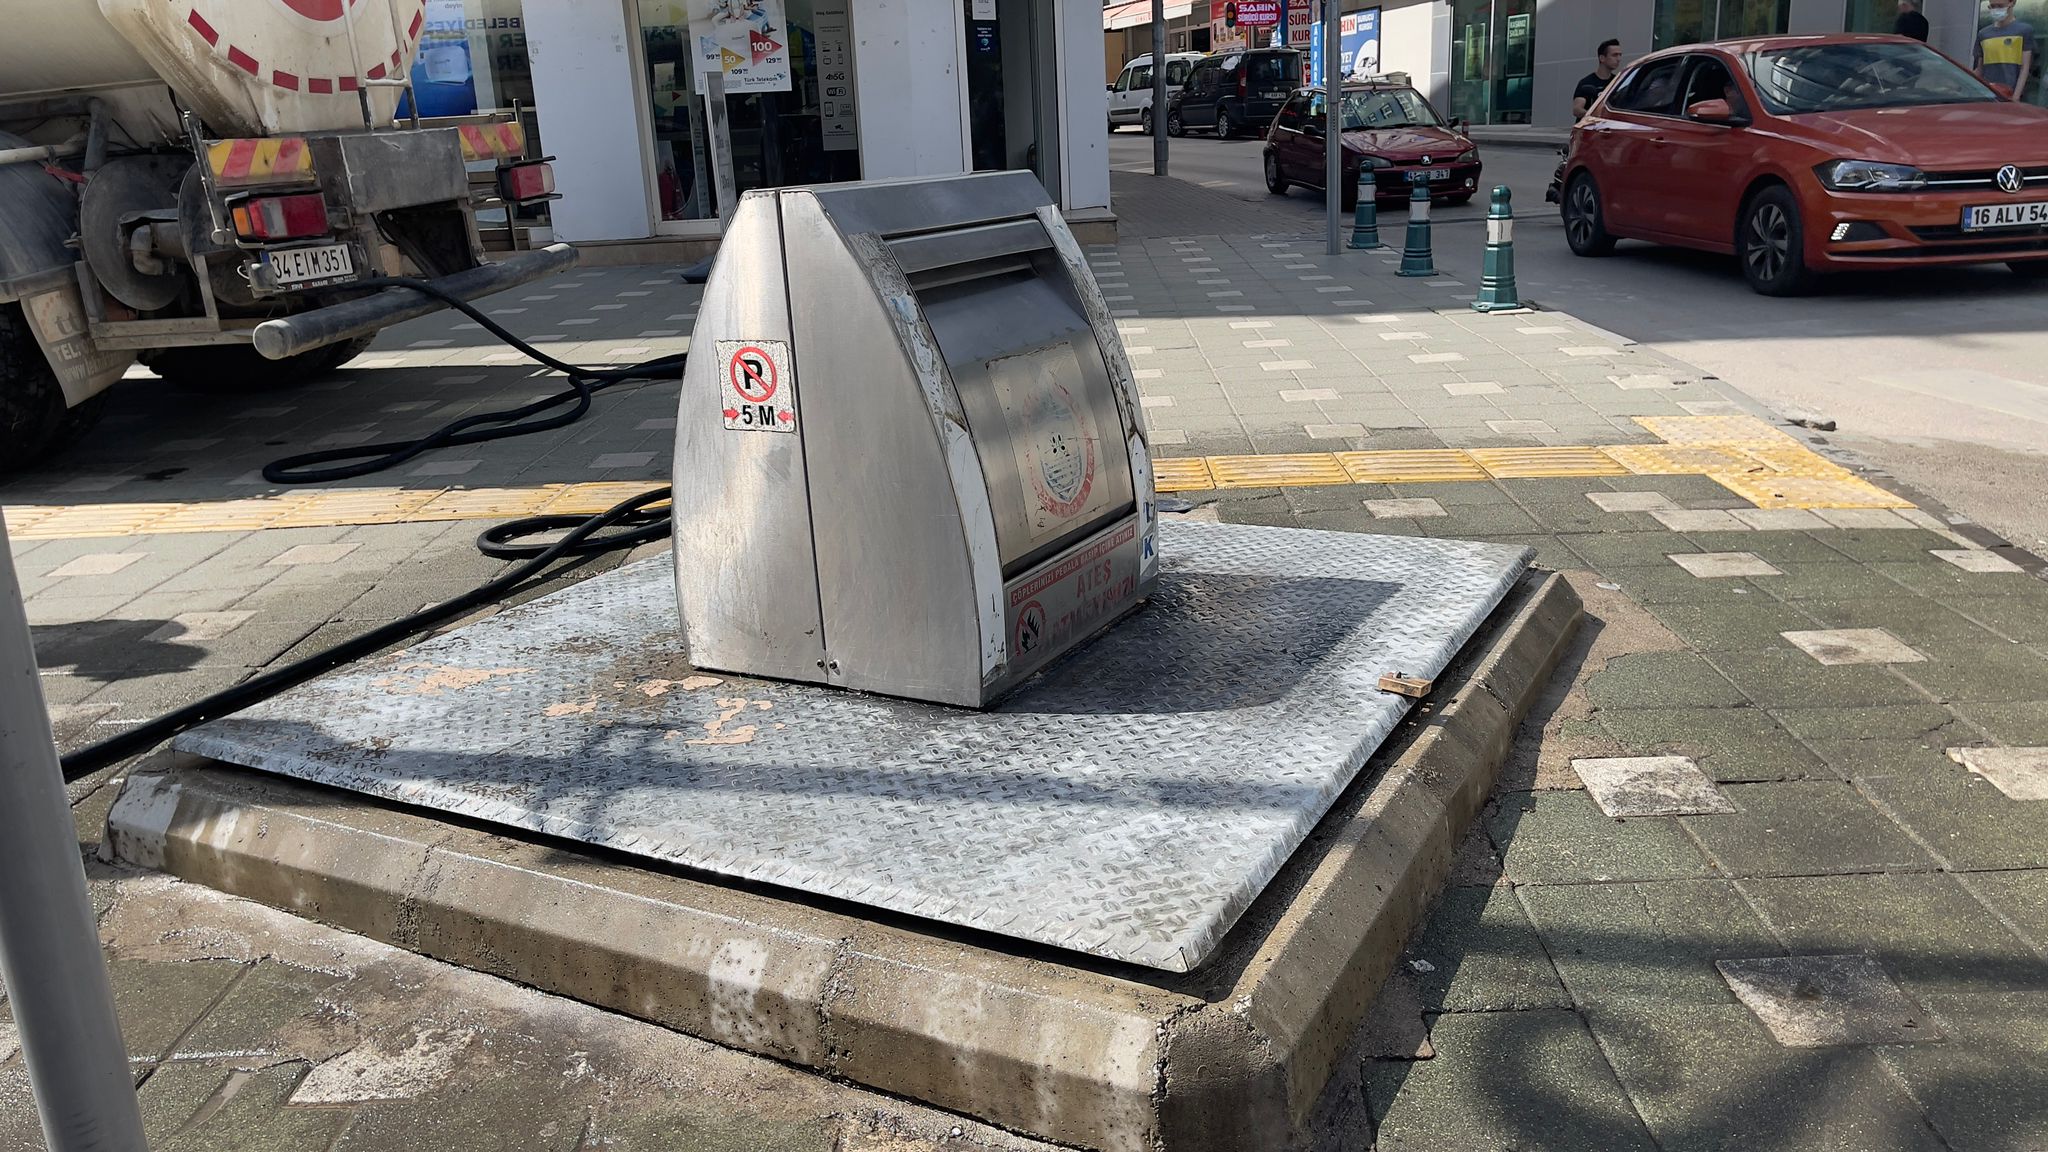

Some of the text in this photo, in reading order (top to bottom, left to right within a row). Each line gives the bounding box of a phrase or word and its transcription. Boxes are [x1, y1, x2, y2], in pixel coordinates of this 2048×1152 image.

[752, 42, 772, 51] 100
[724, 56, 736, 64] 50
[1974, 208, 1991, 225] 16
[1995, 206, 2025, 224] ALV
[272, 254, 291, 279] 34
[322, 248, 347, 273] 351
[742, 404, 776, 426] 5 M
